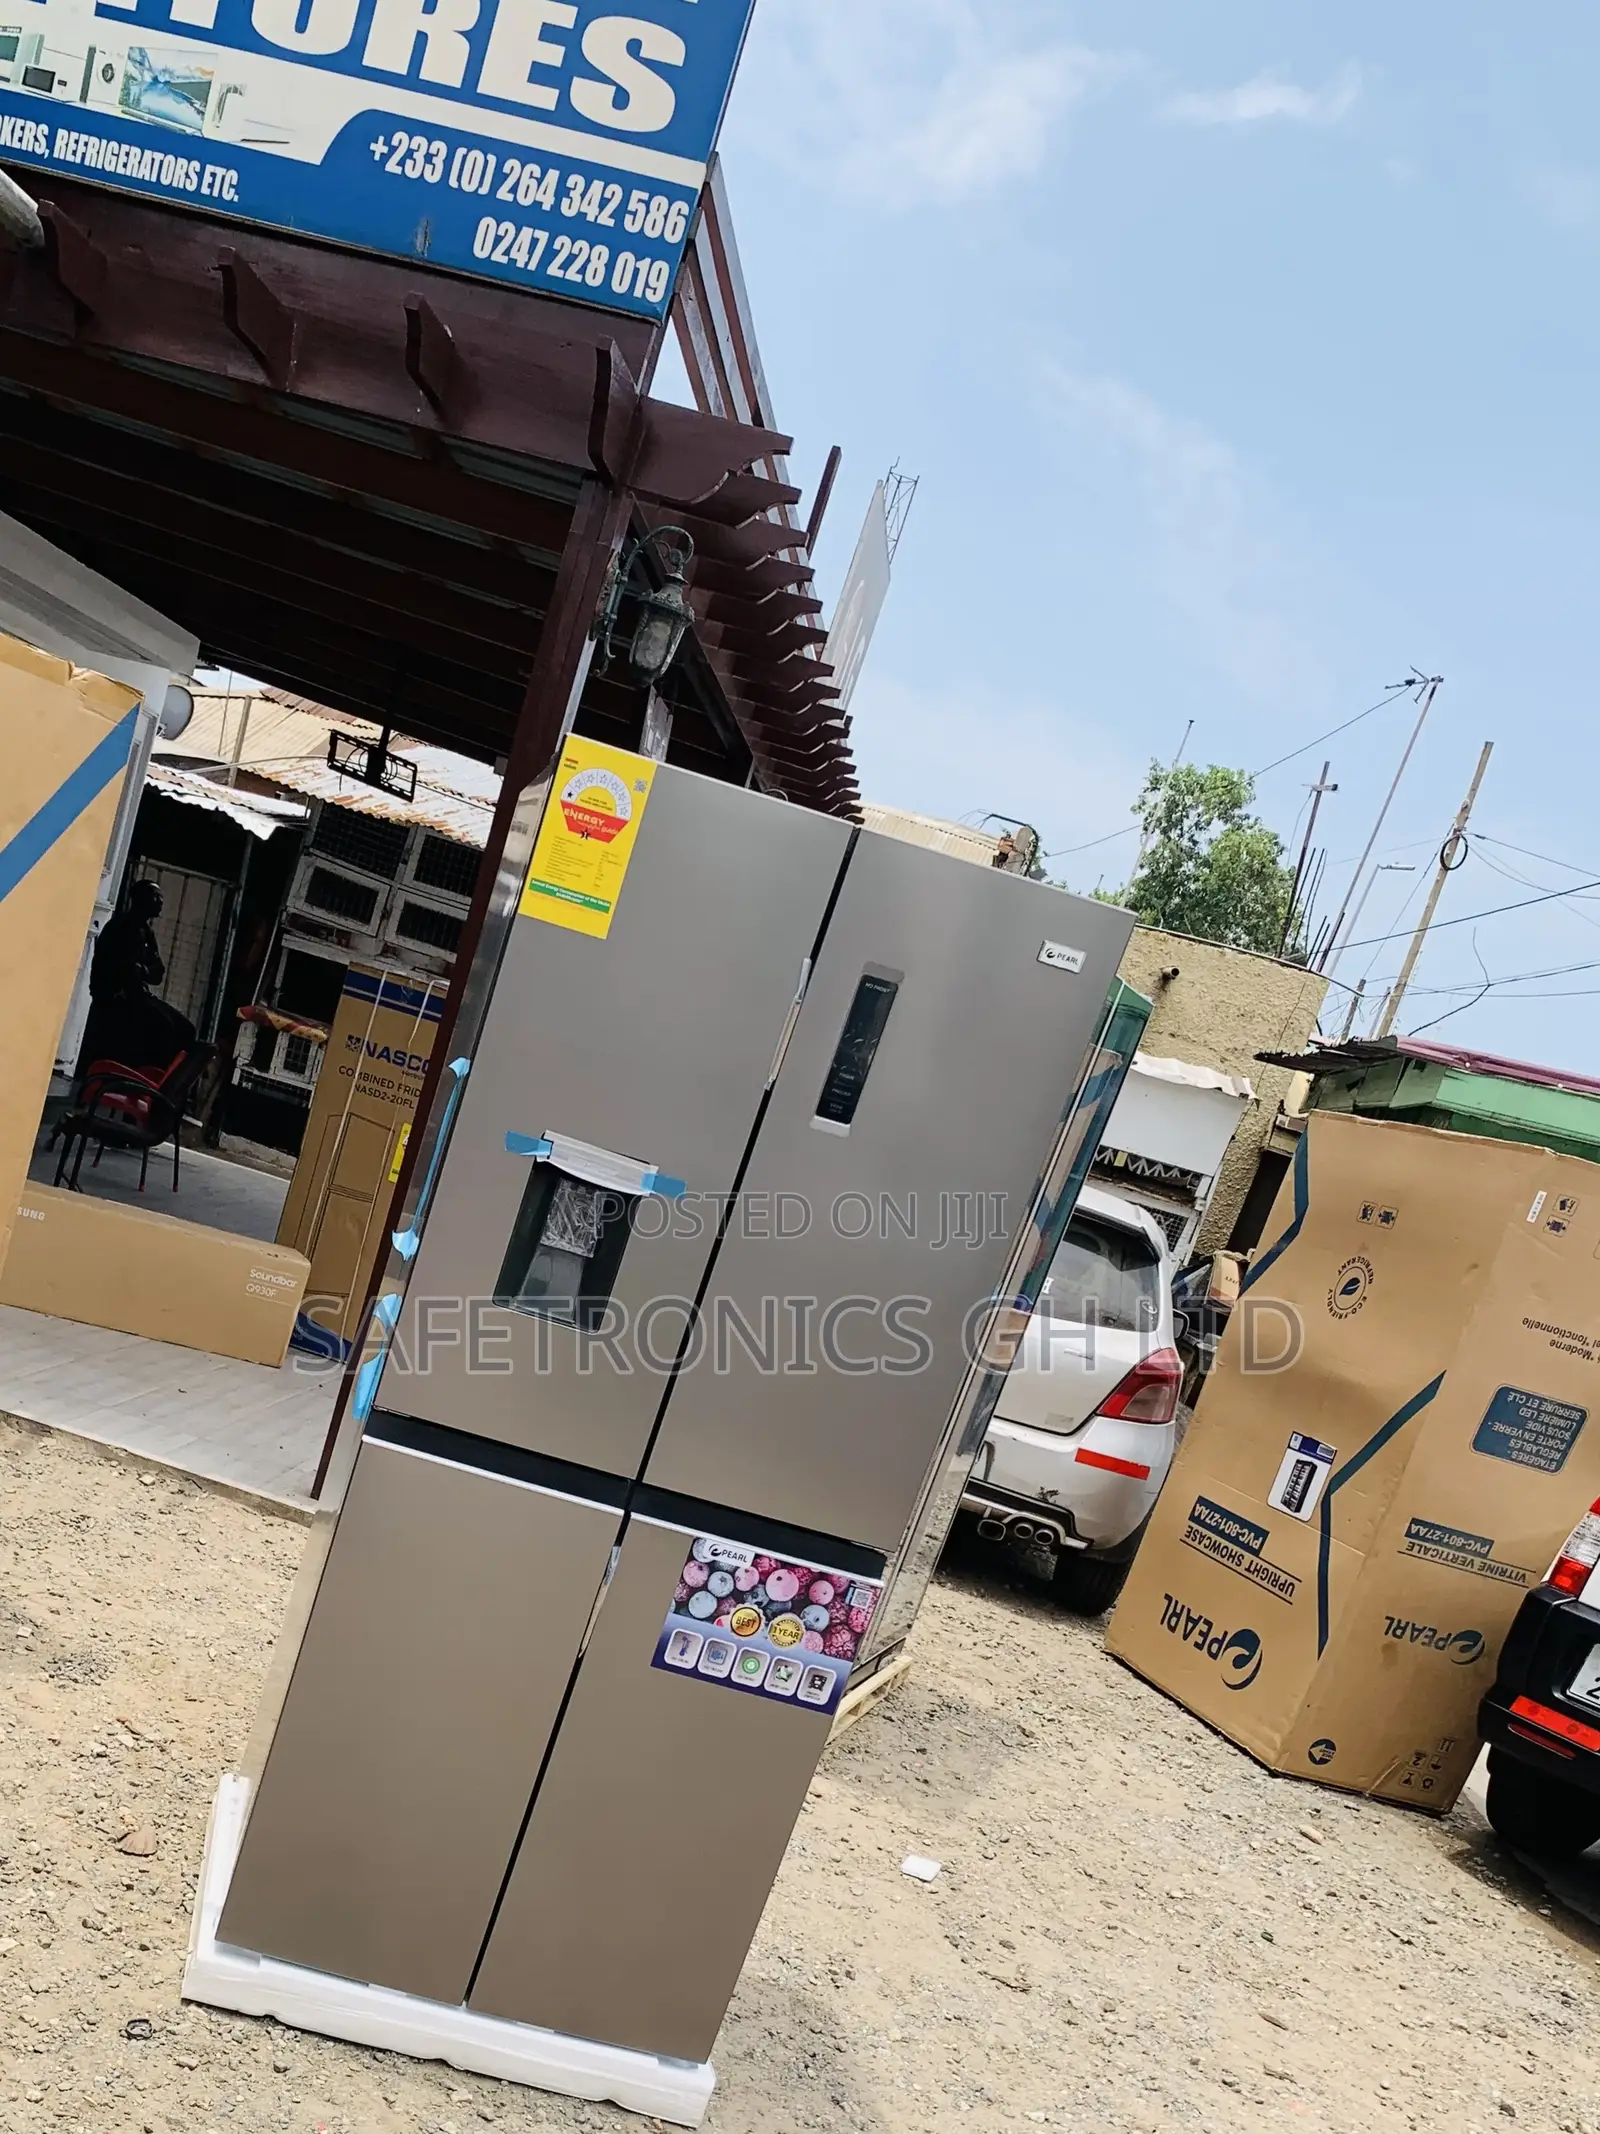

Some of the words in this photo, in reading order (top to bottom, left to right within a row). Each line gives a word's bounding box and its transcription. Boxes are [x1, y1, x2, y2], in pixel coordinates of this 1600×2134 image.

[0, 114, 50, 160] KERS,
[53, 128, 201, 192] REFRIGERATORS
[201, 164, 240, 203] ETC.
[369, 131, 448, 184] +233
[448, 147, 497, 195] (0)
[496, 158, 561, 212] 264
[560, 173, 623, 228] 342
[623, 189, 690, 244] 586
[473, 216, 549, 272] 0247
[546, 236, 610, 287] 228
[611, 251, 671, 304] 019
[1056, 952, 1080, 965] PEARL
[250, 1268, 298, 1289] Soundbar
[1337, 1255, 1374, 1285] REFRIGERANT
[246, 1282, 278, 1299] Q930F
[1327, 1289, 1367, 1320] ECO-FRIENDLY
[1518, 1407, 1538, 1419] LED
[1527, 1398, 1540, 1408] ET
[1539, 1401, 1582, 1420] SERRURE
[1523, 1431, 1537, 1442] EN
[1525, 1420, 1547, 1434] VIDE
[1547, 1427, 1572, 1440] SOUS
[1537, 1435, 1566, 1451] PORTE
[1193, 1503, 1263, 1550] PVC-801-27AA
[1184, 1525, 1245, 1568] SHOWCASE
[1411, 1523, 1490, 1555] PVC-801-27AA
[721, 1549, 748, 1564] PEARL
[1405, 1541, 1475, 1569] VERTICALE
[1244, 1559, 1296, 1598] UPRIGHT
[1477, 1560, 1527, 1584] VITRINE
[735, 1615, 757, 1630] BEST
[1159, 1592, 1229, 1662] PEARL
[1383, 1615, 1453, 1651] PEARL
[778, 1628, 800, 1641] YEAR
